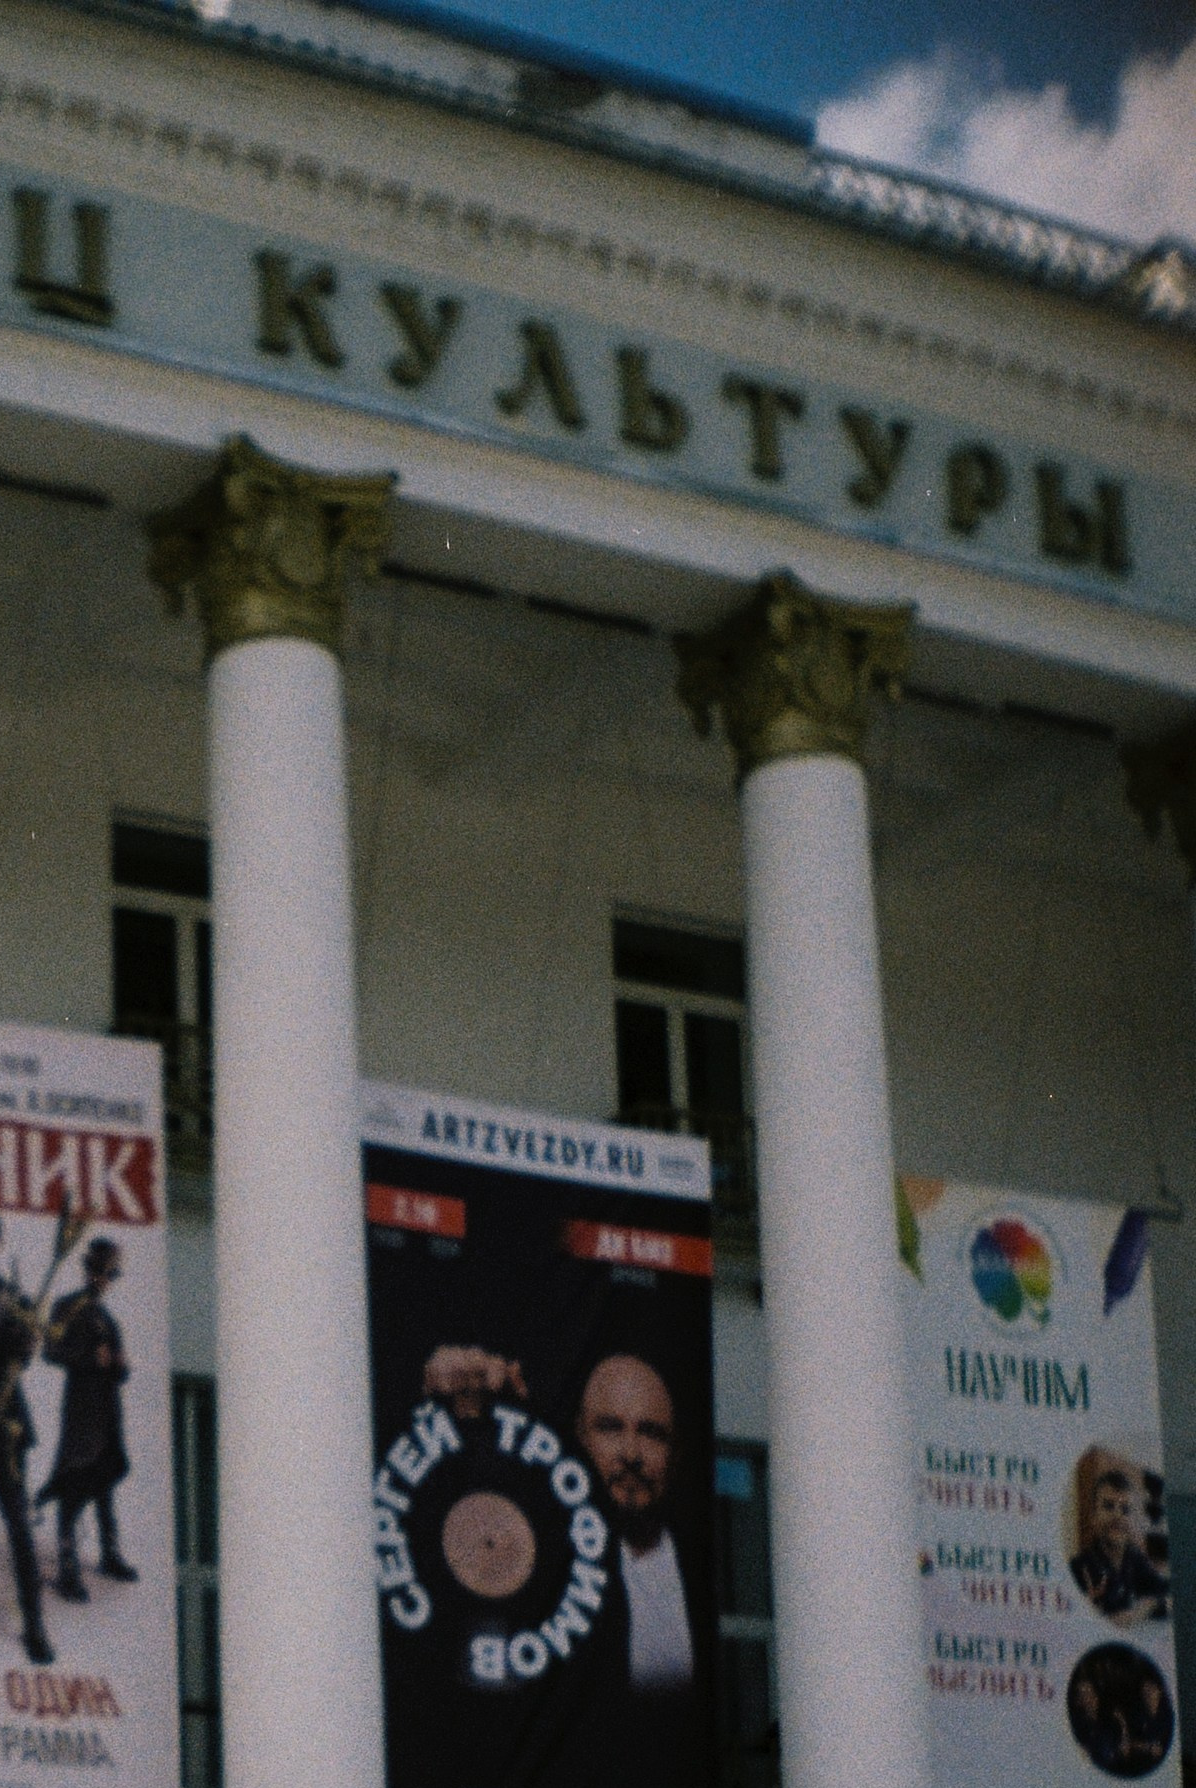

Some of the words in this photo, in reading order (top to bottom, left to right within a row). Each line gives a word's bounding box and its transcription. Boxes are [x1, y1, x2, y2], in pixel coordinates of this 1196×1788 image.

[252, 248, 1130, 577] КУЛЬТУРЫ
[421, 1107, 645, 1178] ARTZVEZDY.RU
[944, 1346, 1090, 1411] НАУЧИМ
[374, 1401, 461, 1631] СЕРГЕЙ
[469, 1404, 607, 1681] ТРОФИМОВ
[6, 1669, 122, 1719] ОДИН
